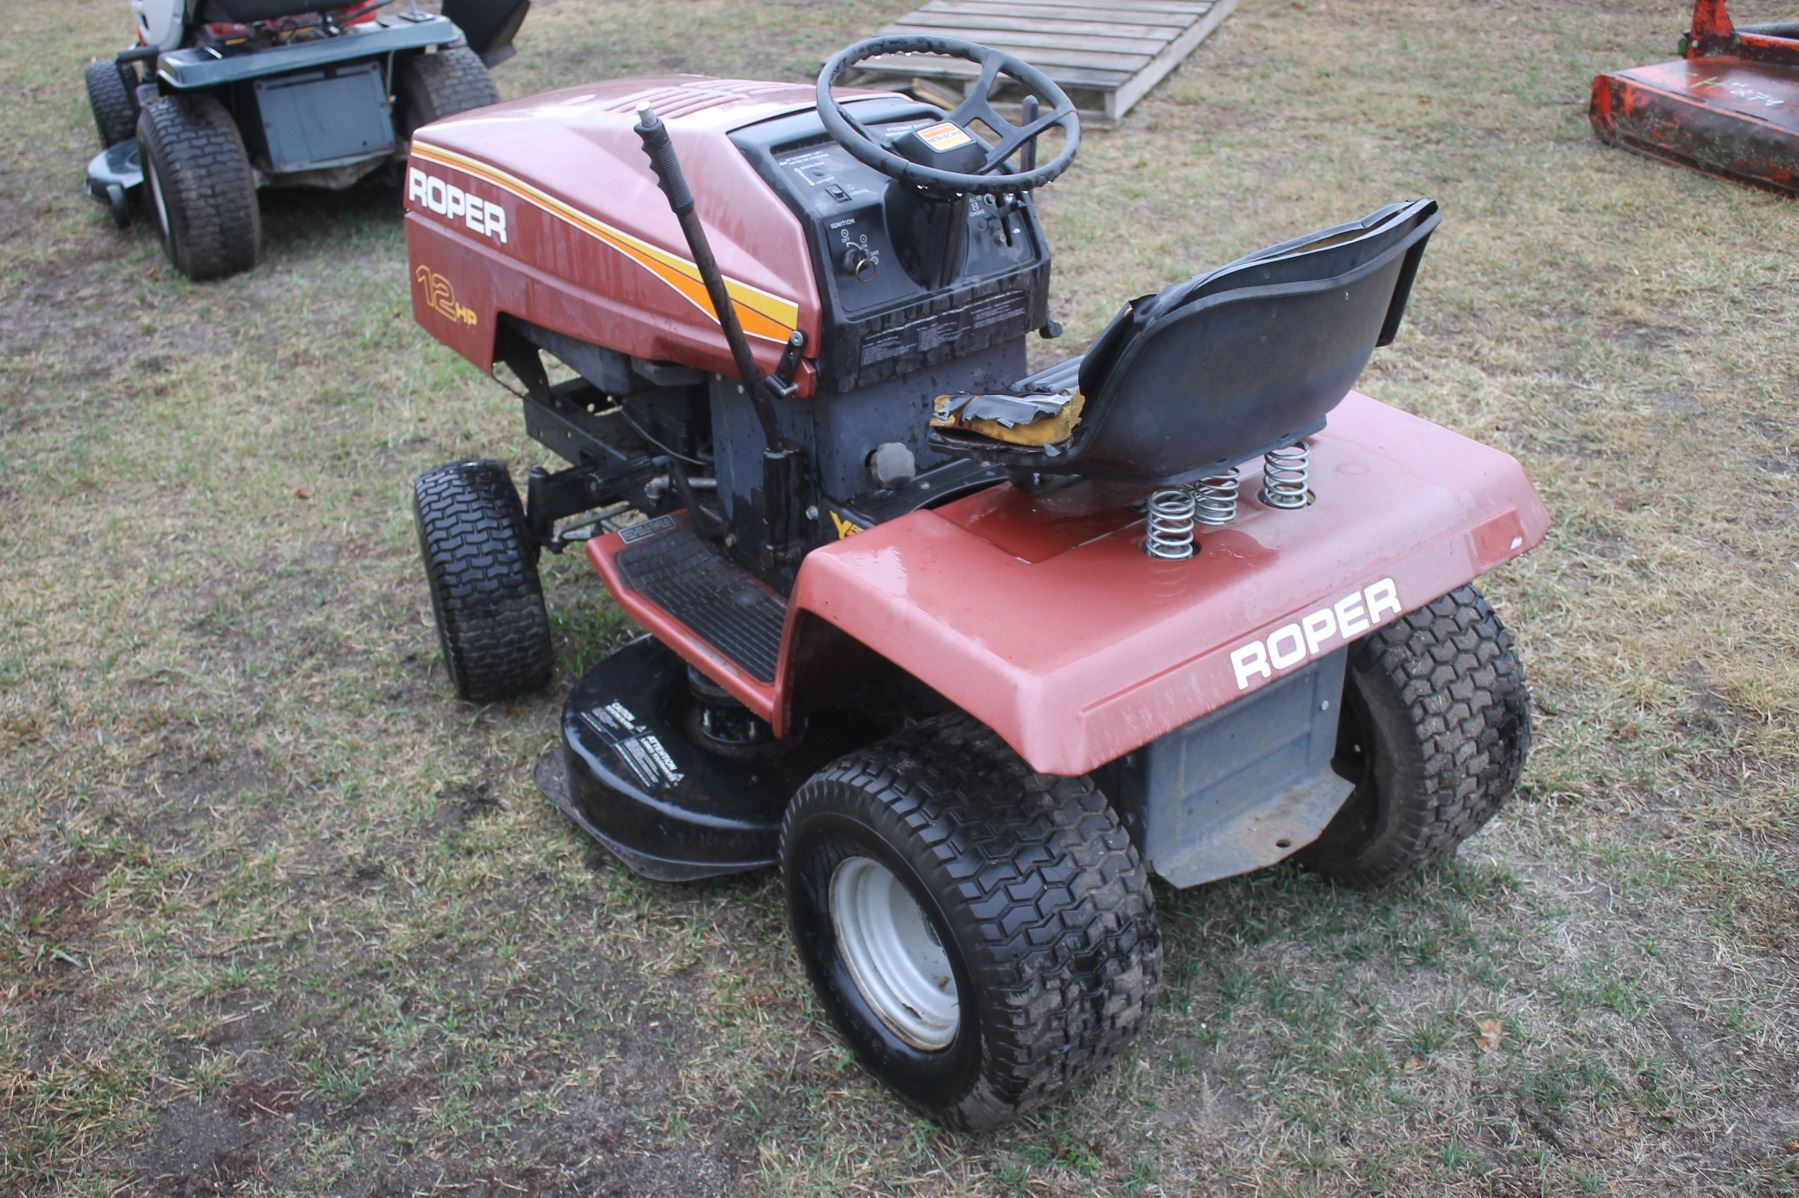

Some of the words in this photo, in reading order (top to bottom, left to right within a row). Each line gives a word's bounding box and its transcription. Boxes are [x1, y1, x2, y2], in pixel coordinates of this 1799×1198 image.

[409, 167, 507, 244] ROPER
[830, 218, 856, 230] IGNITION
[1230, 577, 1402, 690] ROPER
